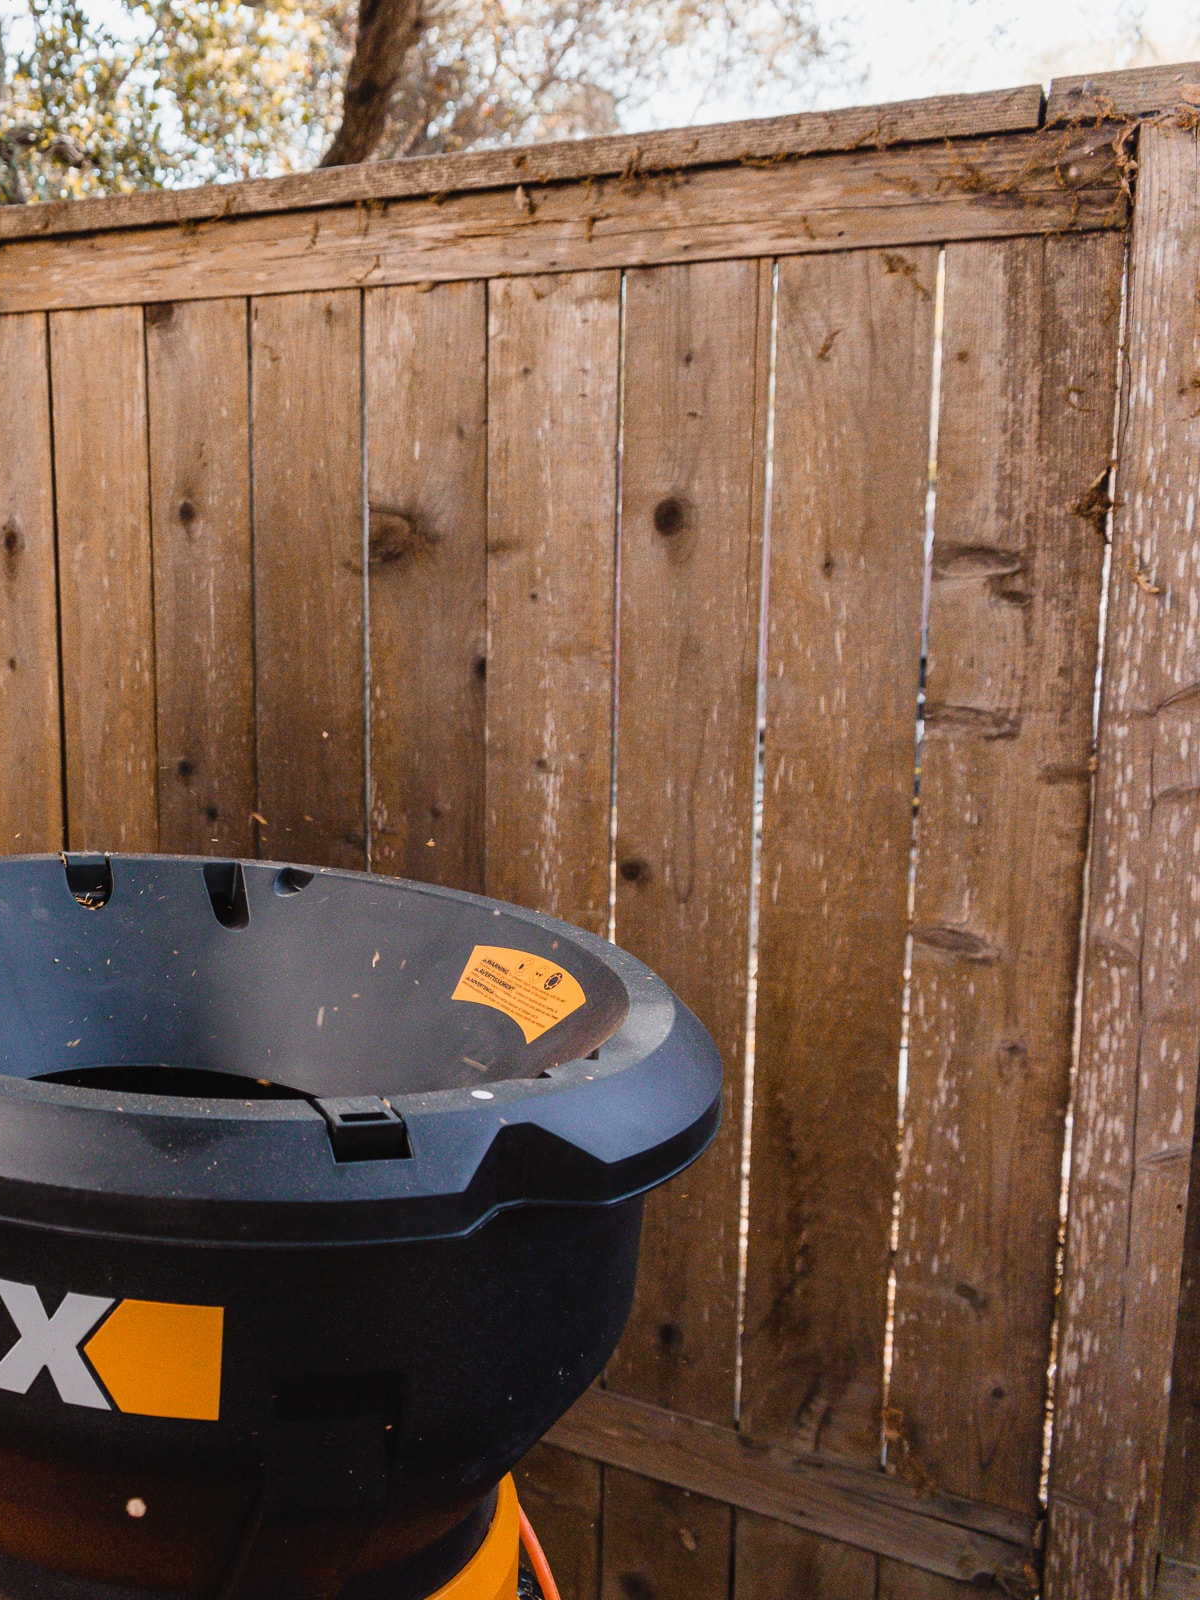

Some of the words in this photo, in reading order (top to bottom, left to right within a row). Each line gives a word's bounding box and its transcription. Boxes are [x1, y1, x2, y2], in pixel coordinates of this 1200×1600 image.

[487, 959, 510, 974] WARNING
[470, 979, 494, 994] ADVERTENCIA
[479, 969, 515, 991] AVERTISSEMENT
